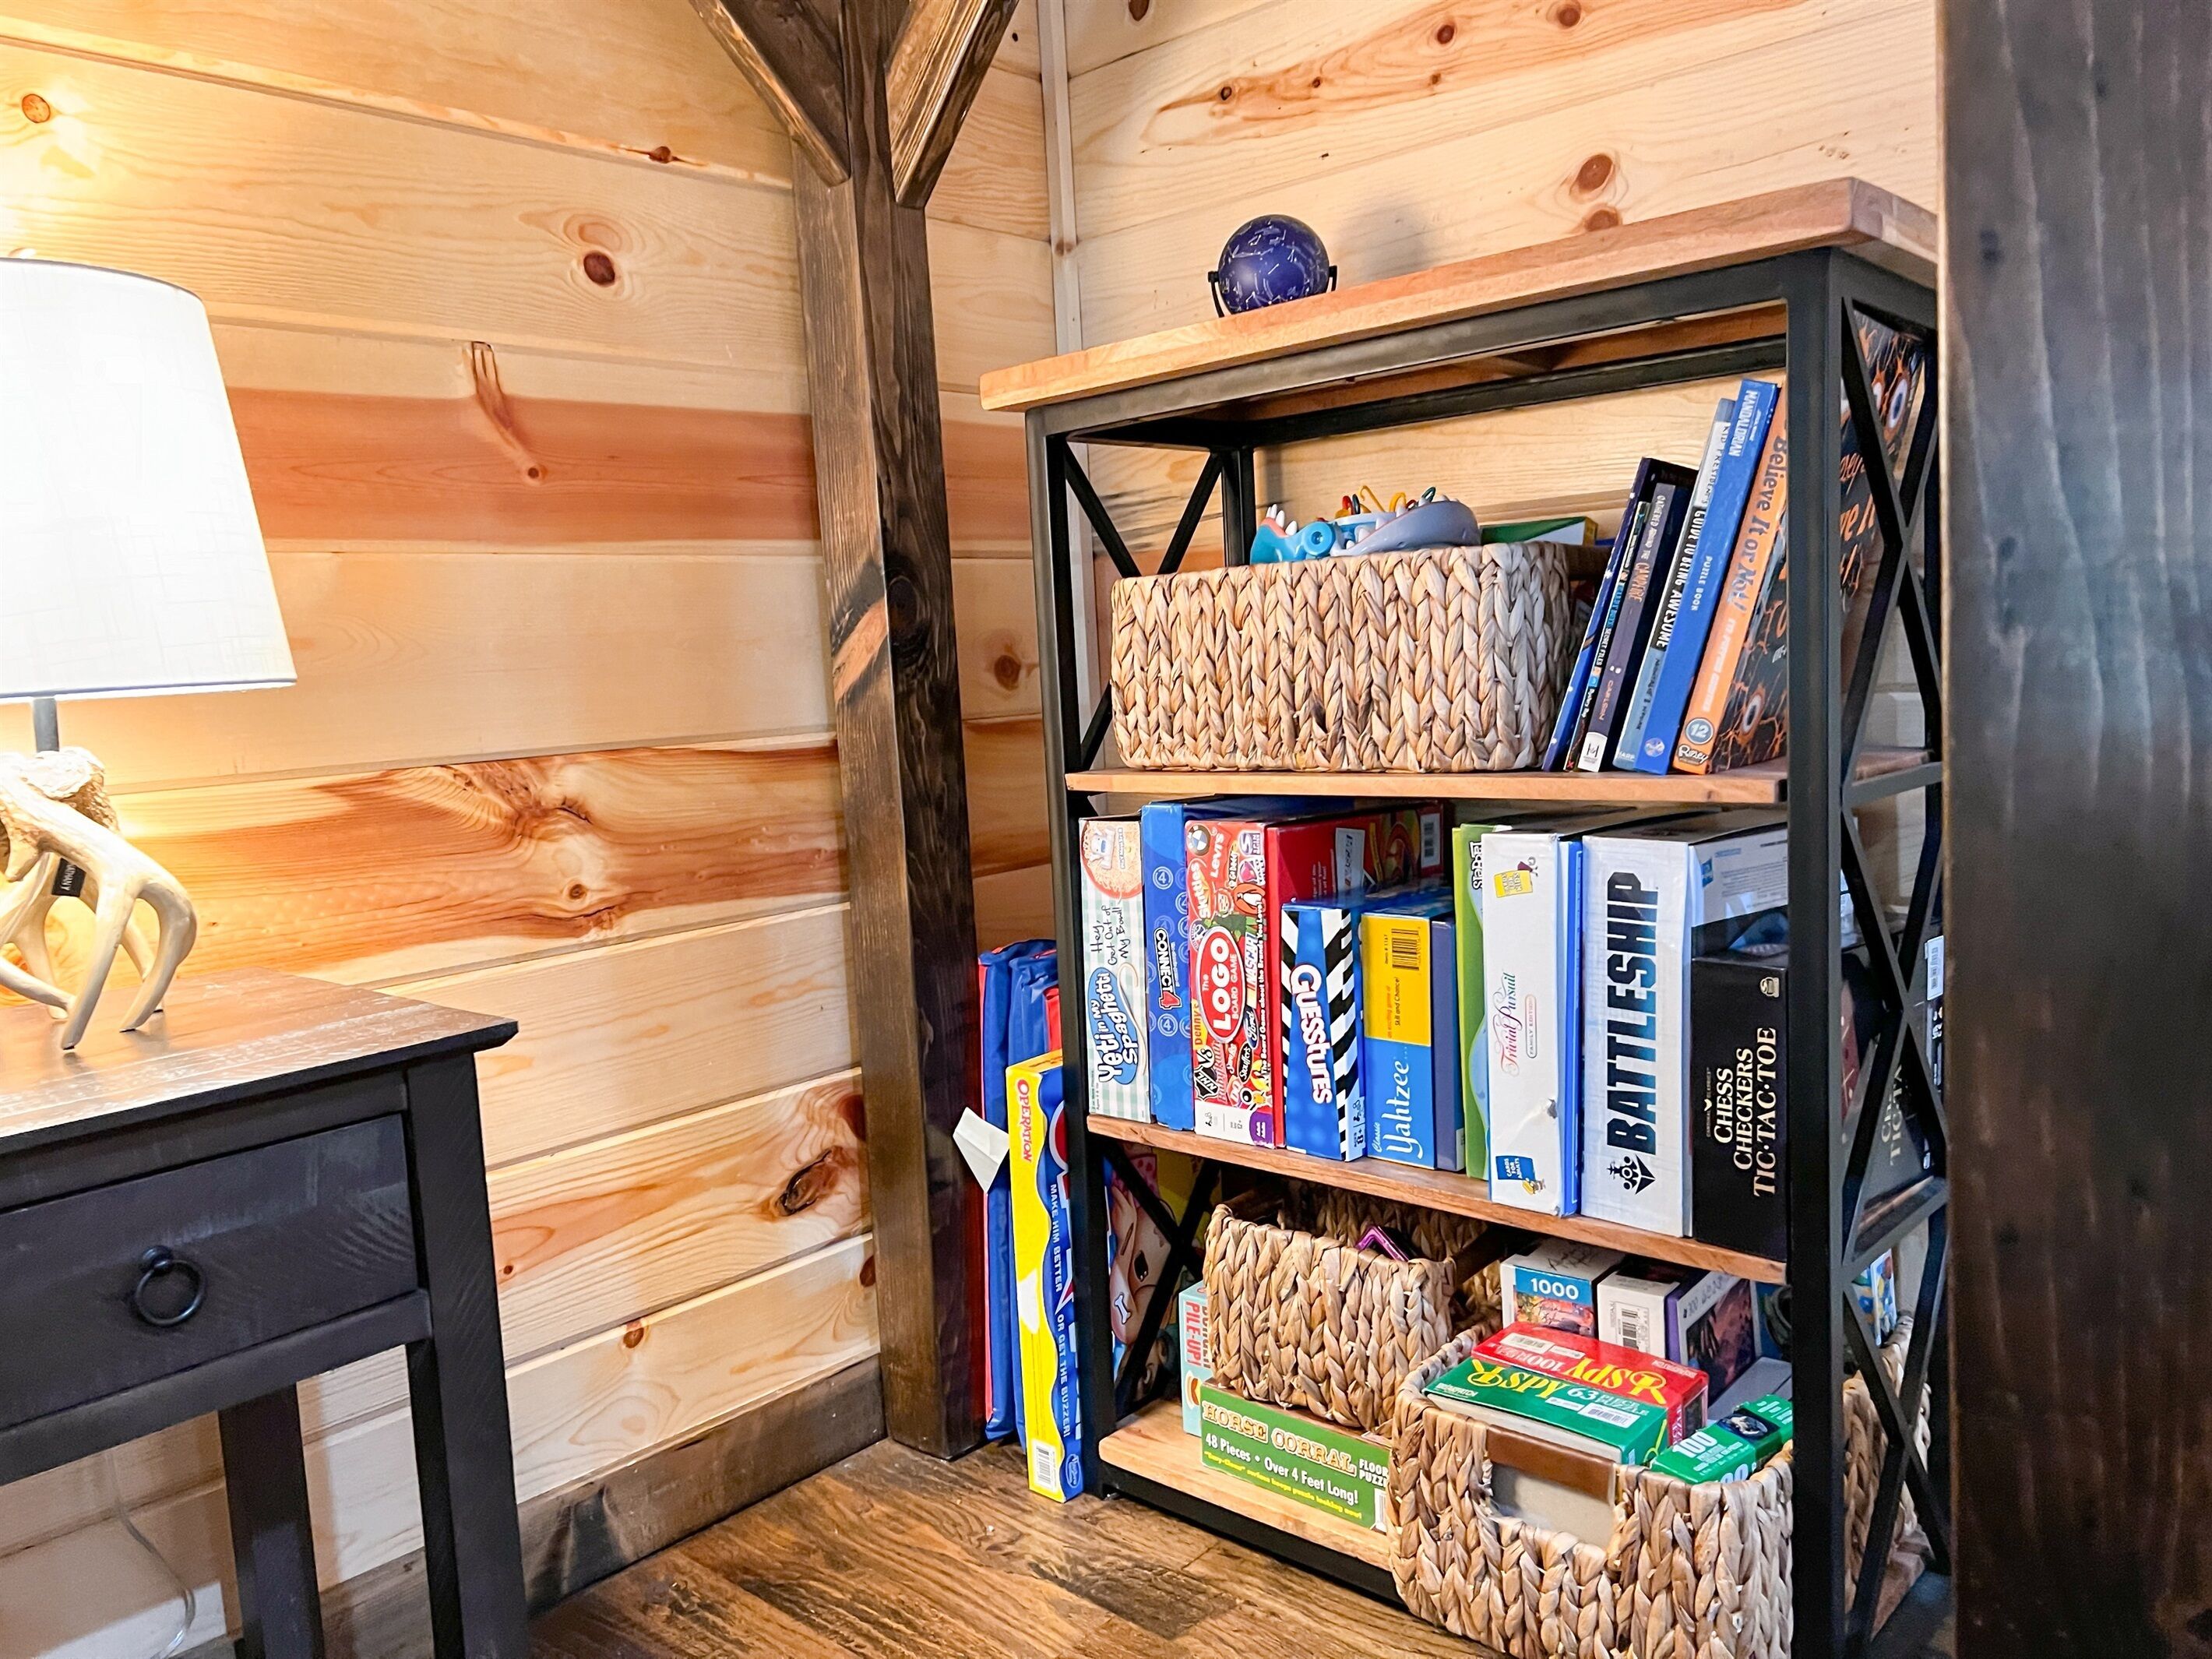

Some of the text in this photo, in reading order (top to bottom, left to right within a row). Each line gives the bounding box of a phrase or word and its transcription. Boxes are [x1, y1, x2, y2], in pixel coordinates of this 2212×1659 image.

[1728, 390, 1759, 456] MANDALORIAN
[1757, 436, 1787, 511] Believe
[1742, 539, 1759, 563] or
[1749, 516, 1770, 536] It
[1629, 562, 1650, 603] CAMPFIRE
[1656, 510, 1708, 648] GUIDE TO BEING AWESOME
[1691, 555, 1713, 611] PUZZLE BOOK
[1691, 724, 1709, 738] 12
[1191, 861, 1210, 918] Skittles
[1090, 920, 1104, 953] Hey,
[1101, 904, 1117, 965] Get Out of
[1118, 939, 1130, 958] My
[1245, 933, 1259, 984] NASCAR
[1156, 929, 1173, 992] CONNECT
[1210, 937, 1231, 1030] LOGO
[1230, 953, 1239, 1020] BOARD GAME
[1096, 972, 1138, 1065] Spaghetti
[1192, 1003, 1203, 1045] Denny's
[1246, 1009, 1257, 1041] Ford
[1493, 972, 1523, 1077] Trivial Pursuit
[1605, 872, 1659, 1156] BATTLESHIP
[1090, 999, 1123, 1083] Yeti in My
[1196, 1048, 1213, 1064] V8
[1196, 1072, 1218, 1090] NHL
[1714, 1068, 1734, 1143] CHESS
[1017, 1079, 1032, 1163] OPERATION
[1382, 1061, 1423, 1159] Yahtzee
[1733, 1048, 1753, 1170] CHECKERS
[1372, 1122, 1382, 1153] Classic
[1051, 1219, 1060, 1245] HIM
[1053, 1245, 1062, 1292] BETTER
[1530, 1278, 1580, 1300] 1000
[1057, 1313, 1065, 1331] OR
[1058, 1332, 1067, 1355] GET
[1185, 1301, 1202, 1367] PILE-UP!
[1059, 1357, 1069, 1384] THE
[1501, 1371, 1568, 1399] SPY
[1567, 1386, 1598, 1400] 63
[1527, 1352, 1564, 1372] 100
[1565, 1358, 1633, 1393] SPY
[1061, 1385, 1071, 1439] BUZZER!
[1202, 1401, 1357, 1477] HORSE CORRAL
[1672, 1432, 1718, 1458] 100
[1205, 1432, 1359, 1506] 48 Pieces Over 4 Feet Long!
